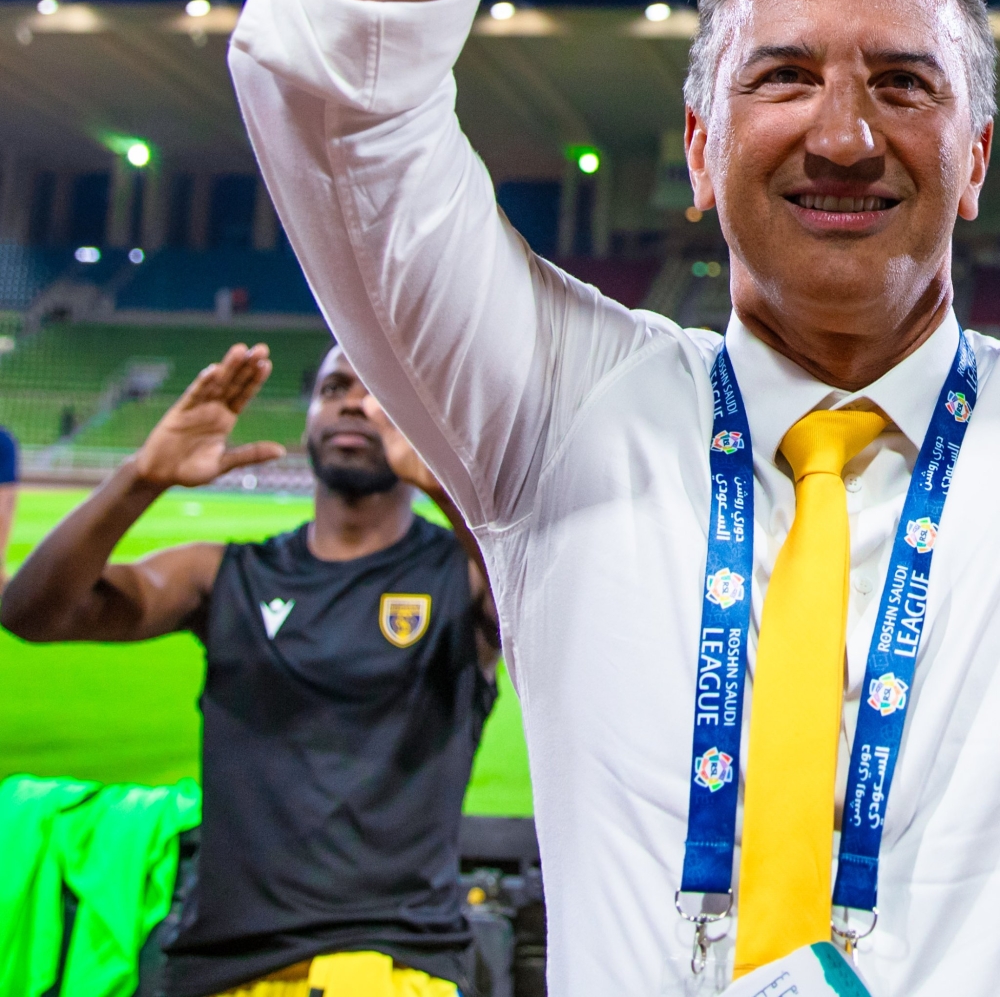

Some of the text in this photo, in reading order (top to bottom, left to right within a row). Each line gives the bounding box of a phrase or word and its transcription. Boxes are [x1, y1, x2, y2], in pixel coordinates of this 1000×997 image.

[710, 364, 724, 420] EAGUE
[723, 384, 738, 415] SAUDI
[919, 436, 945, 492] دوري روشن
[711, 473, 731, 541] السعودي
[731, 476, 748, 542] دوري روشن
[877, 565, 909, 653] ROSHN SAUDI
[893, 569, 930, 658] LEAGUE
[696, 627, 725, 727] LEAGUE
[723, 628, 741, 727] ROSHN SAUDI
[850, 744, 872, 827] دوري روشن
[868, 746, 891, 830] السعودي
